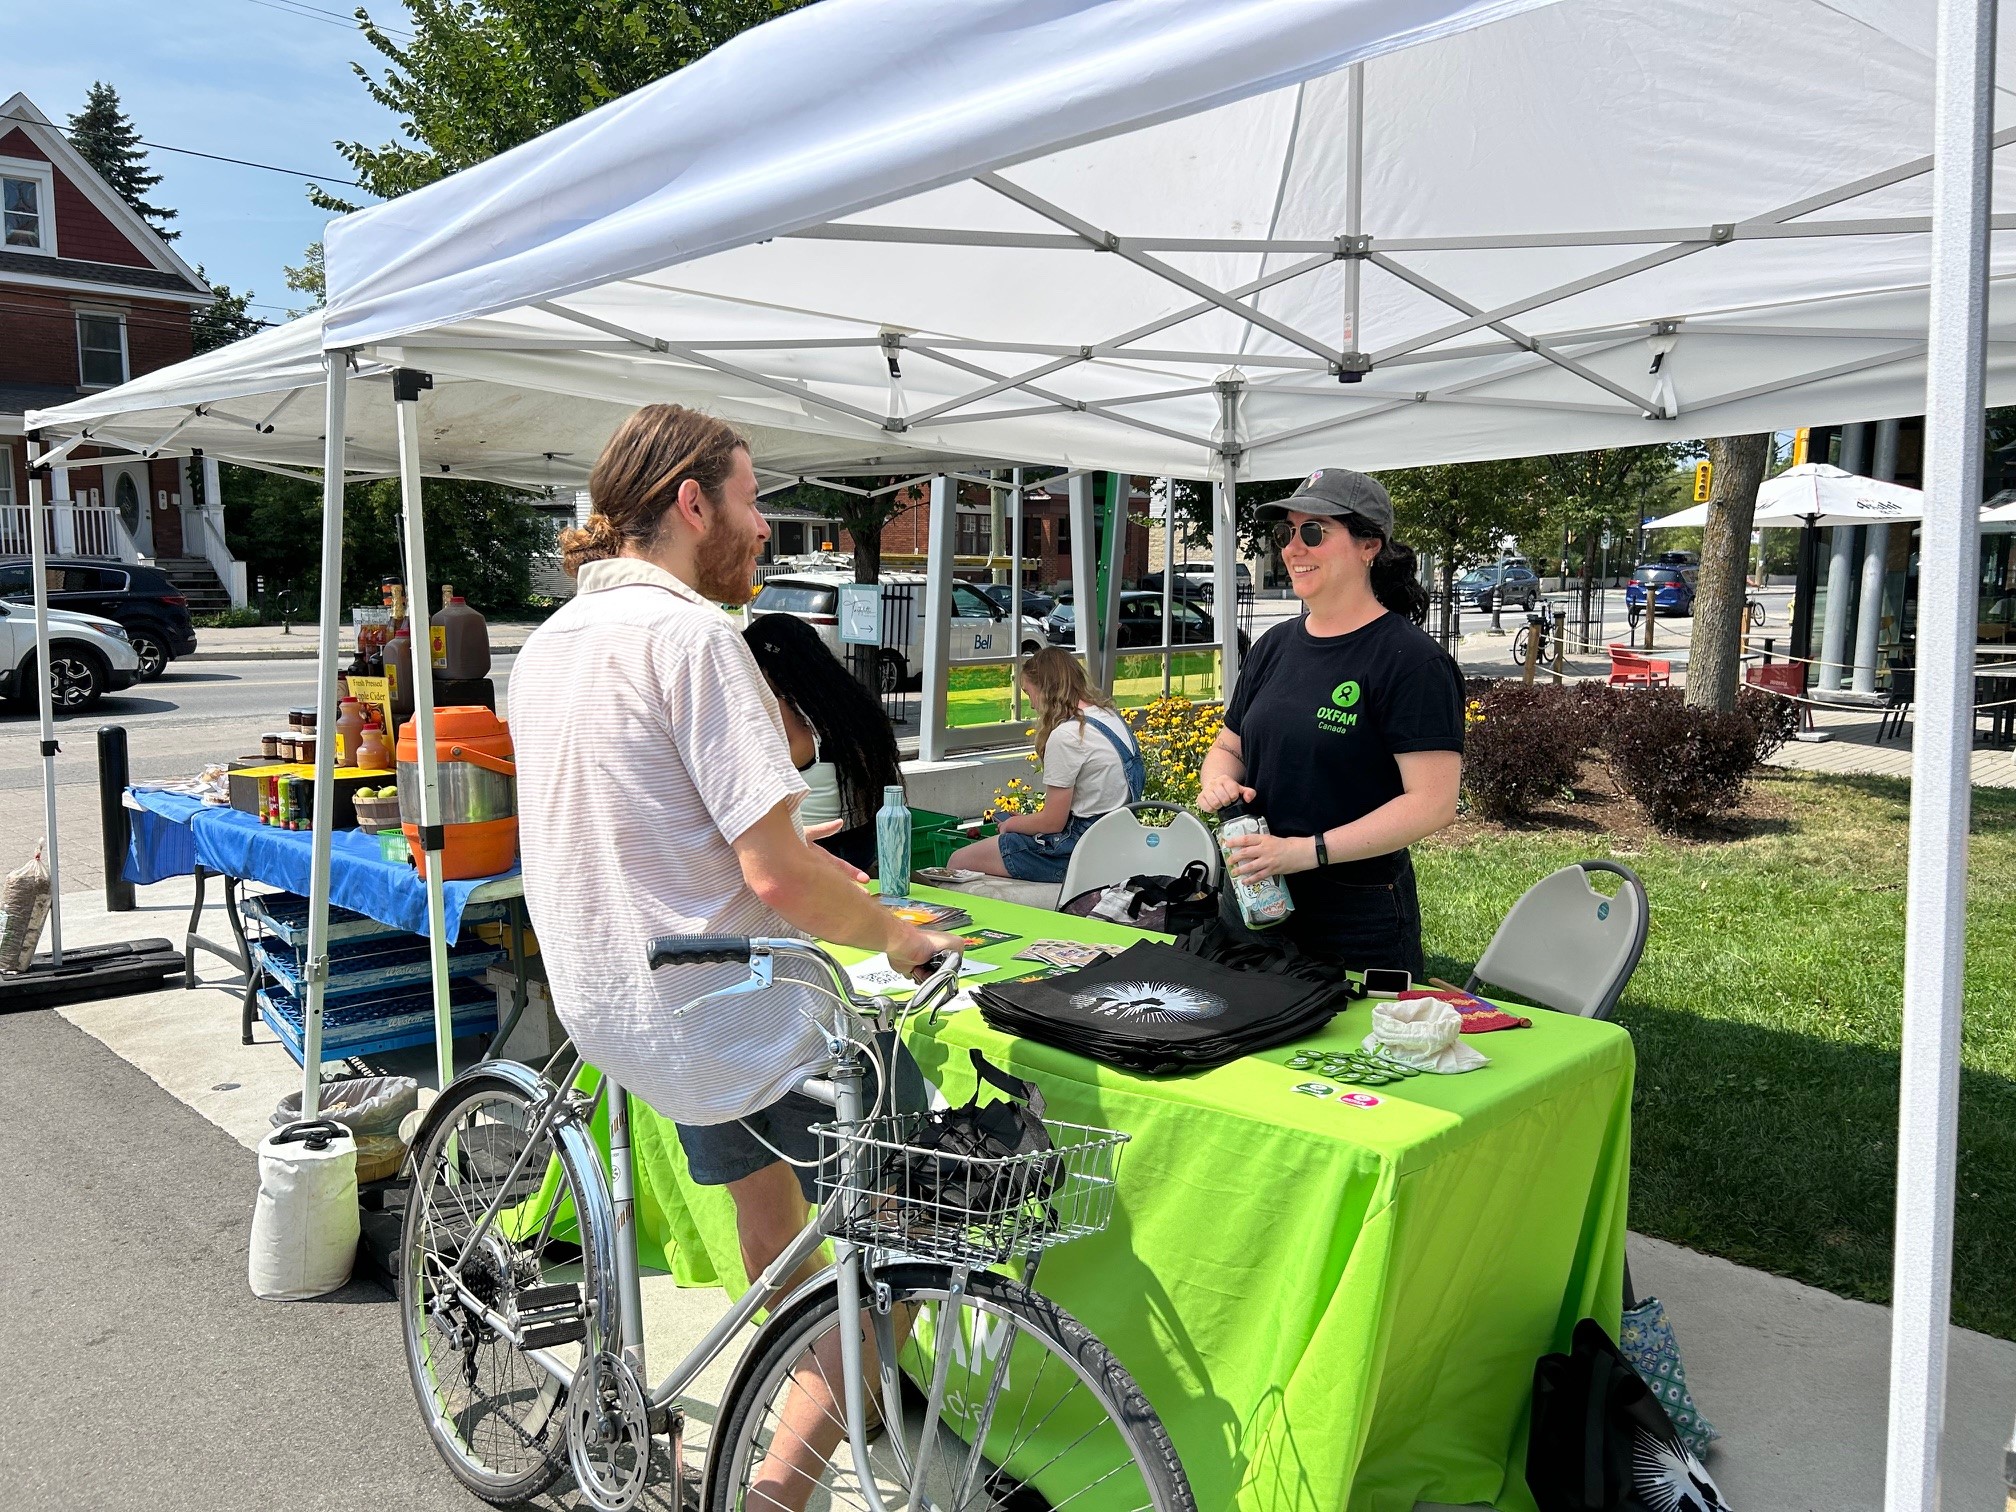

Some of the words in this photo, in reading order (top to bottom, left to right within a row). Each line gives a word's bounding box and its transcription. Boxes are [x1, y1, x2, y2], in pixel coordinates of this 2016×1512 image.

[974, 634, 992, 650] Bell
[352, 679, 365, 687] Fresh
[365, 679, 383, 687] Pressed
[354, 691, 369, 702] Apple
[369, 691, 385, 701] Cider
[1316, 706, 1358, 727] OXFAM
[1318, 721, 1347, 735] Canada
